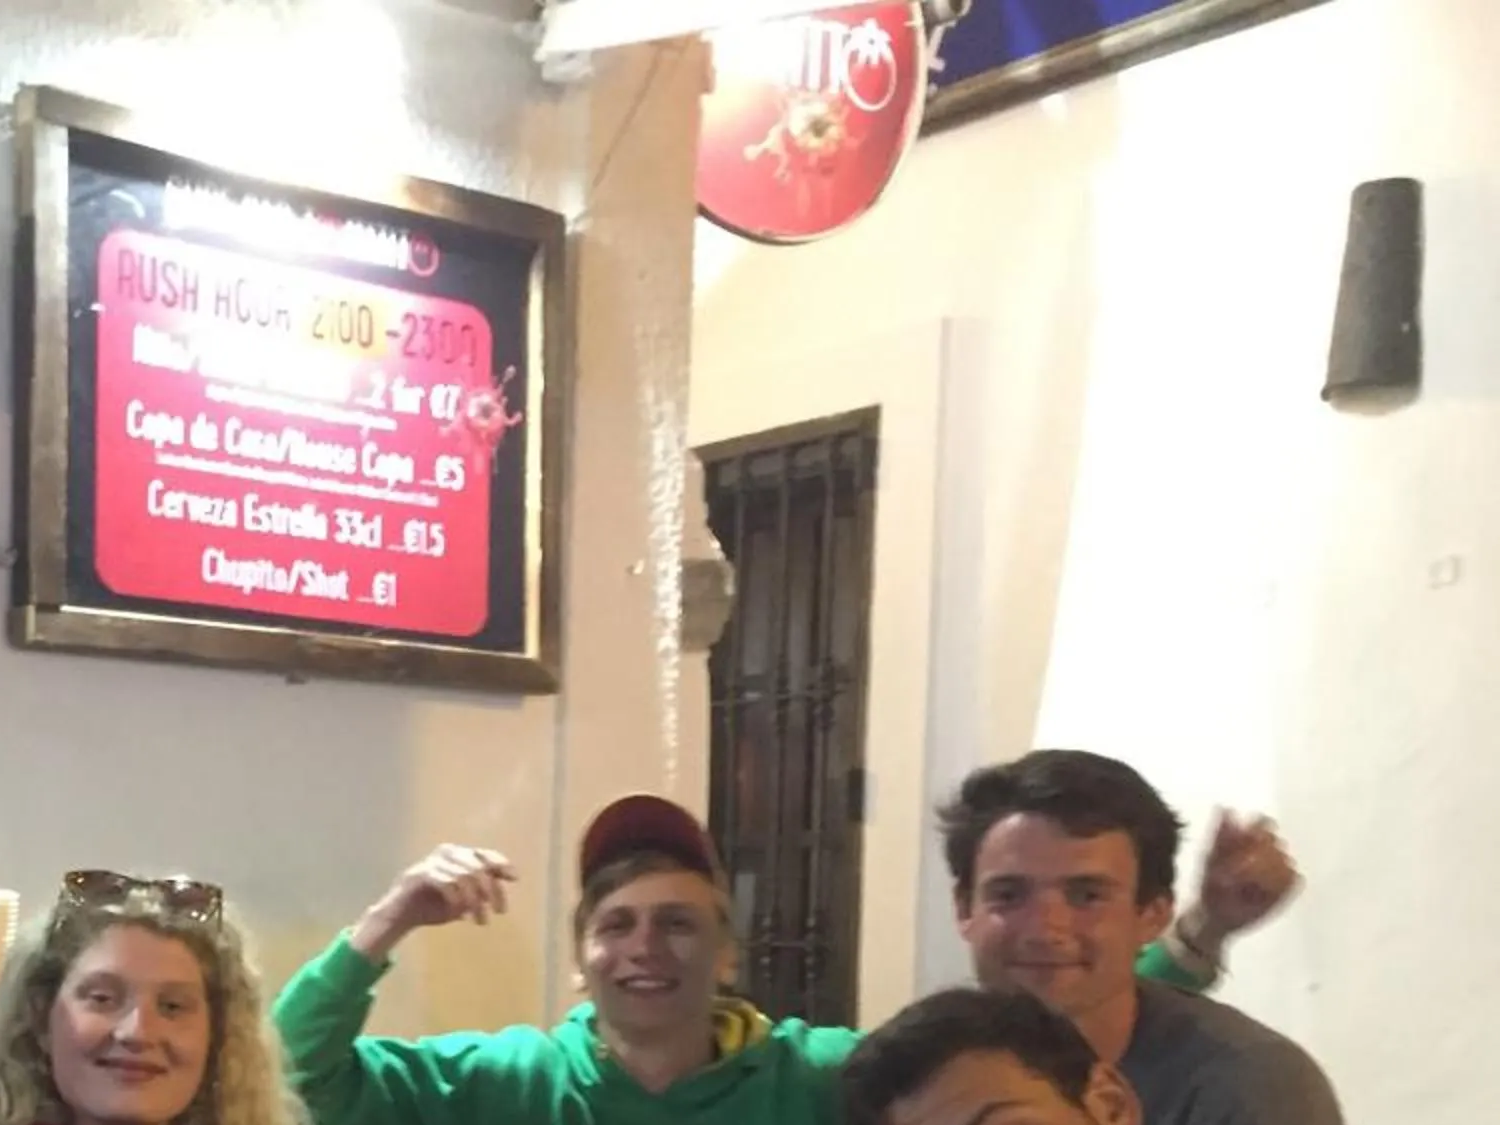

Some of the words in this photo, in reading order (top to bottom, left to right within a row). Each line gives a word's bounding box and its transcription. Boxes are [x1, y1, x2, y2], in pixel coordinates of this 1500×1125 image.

[117, 248, 199, 313] RUSH
[126, 399, 185, 449] Copa
[190, 412, 219, 451] de
[362, 441, 414, 493] Copa
[148, 480, 237, 528] Cerveza
